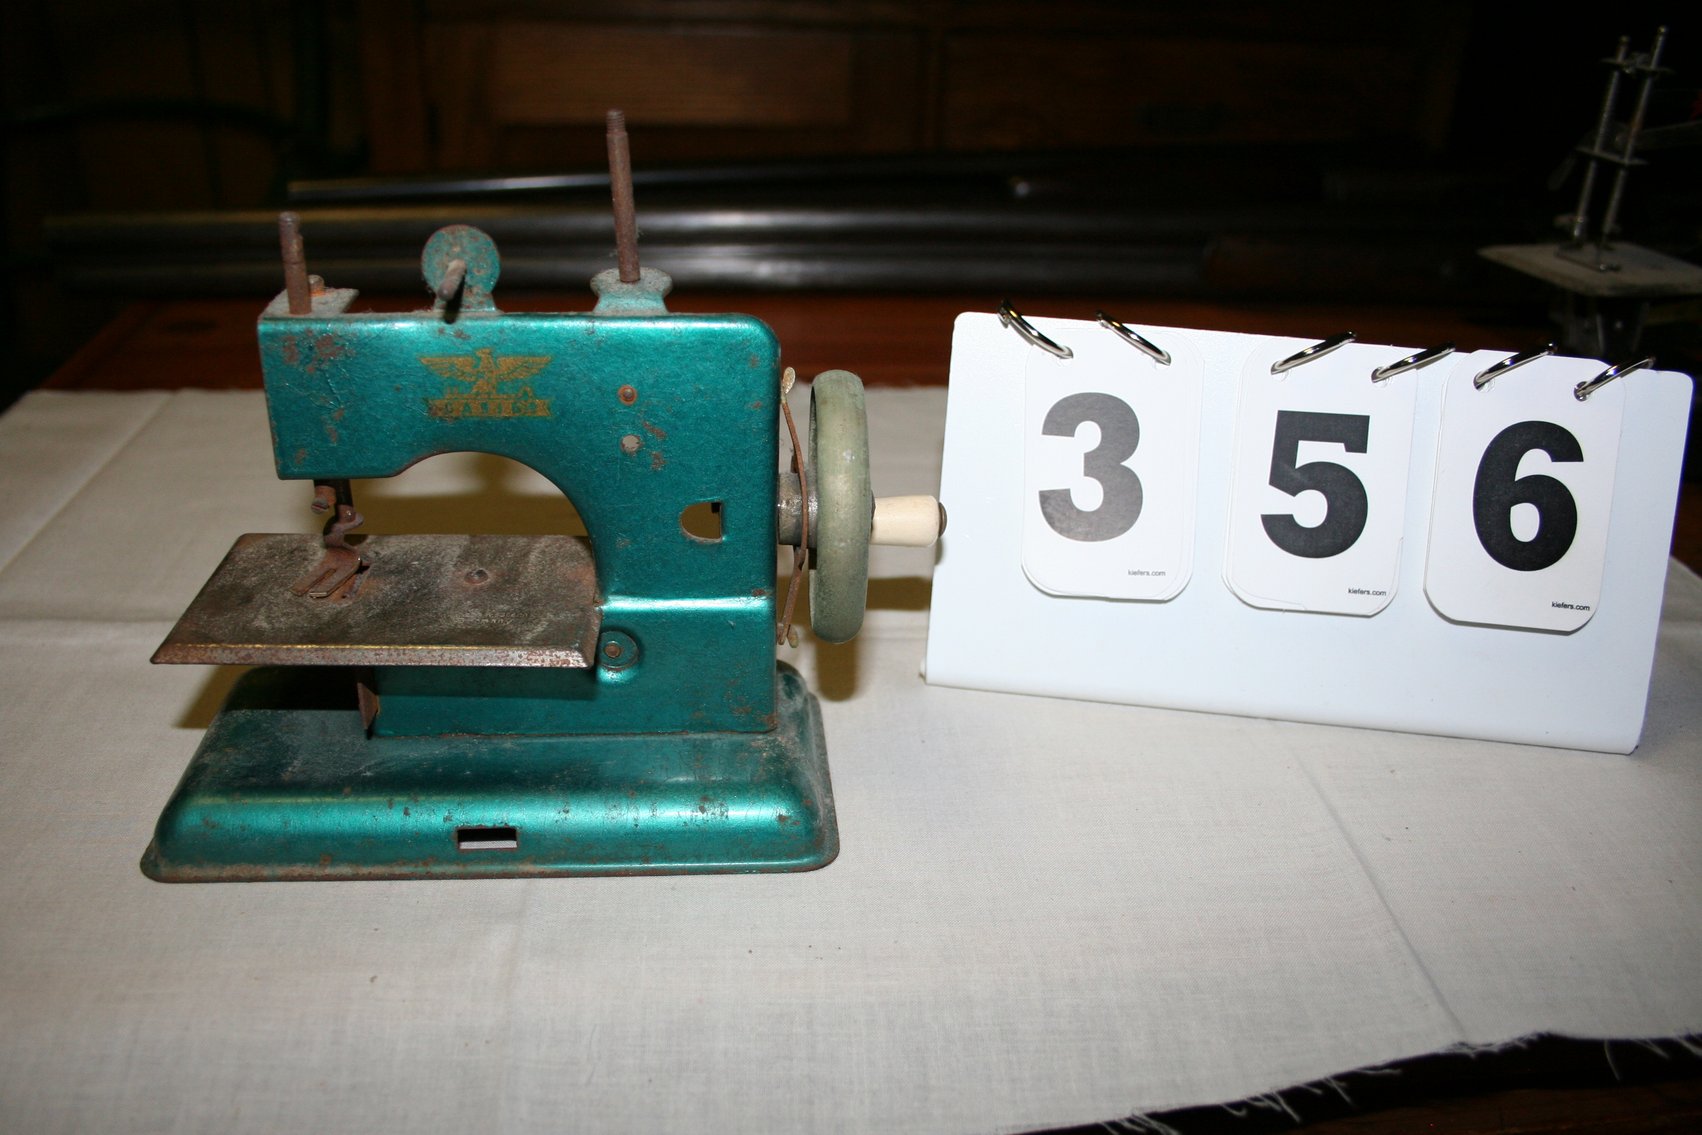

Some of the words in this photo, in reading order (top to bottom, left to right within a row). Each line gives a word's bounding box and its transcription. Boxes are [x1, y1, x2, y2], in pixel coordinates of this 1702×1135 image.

[1039, 393, 1143, 541] 3
[1261, 410, 1370, 558] 5
[1473, 421, 1584, 571] 6
[1127, 568, 1167, 577] kiefers.com
[1347, 587, 1387, 597] kiefers.com
[1551, 601, 1591, 612] kiefers.com
